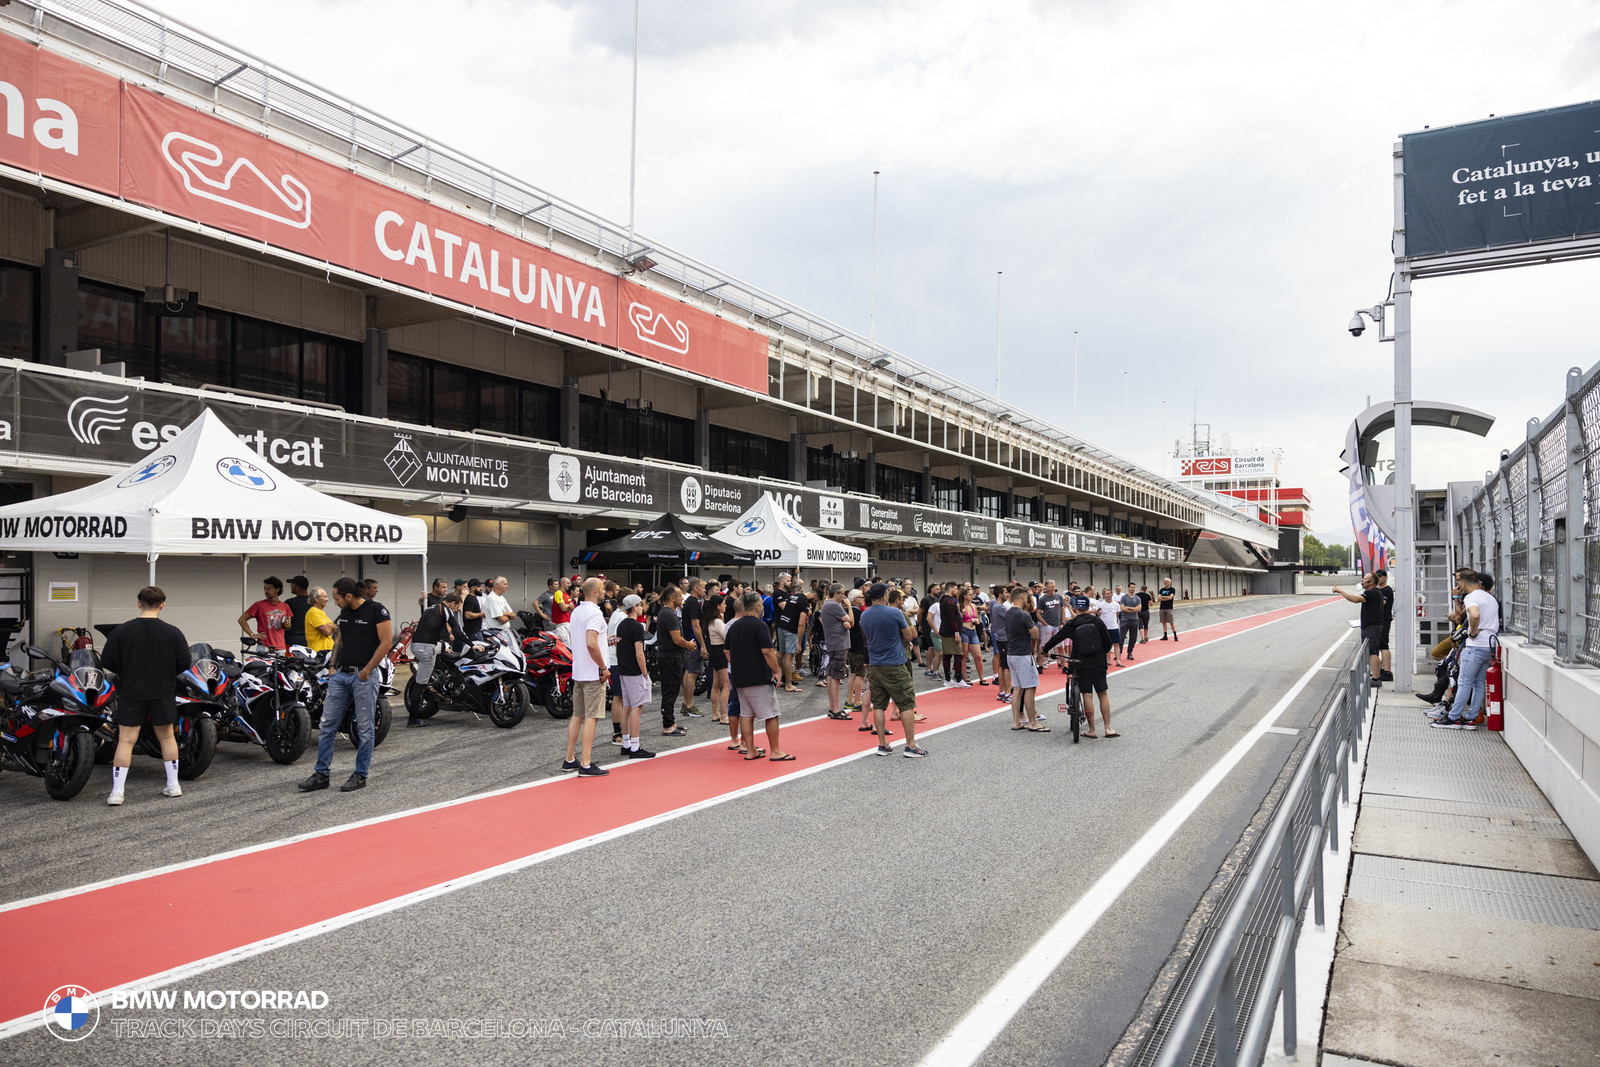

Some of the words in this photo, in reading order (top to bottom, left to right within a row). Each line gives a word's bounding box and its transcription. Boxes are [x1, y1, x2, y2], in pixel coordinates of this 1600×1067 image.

[1452, 155, 1579, 184] Catalunya,
[1458, 189, 1487, 205] fet
[1494, 187, 1507, 200] a
[1514, 181, 1535, 197] la
[1542, 175, 1592, 193] teva
[374, 210, 606, 327] CATALUNYA
[426, 451, 493, 470] AJUNTAMENT
[495, 459, 509, 472] DE
[426, 466, 509, 488] MONTMELÓ
[584, 465, 646, 487] Ajuntament
[585, 484, 599, 499] de
[601, 485, 653, 505] Barcelona
[704, 484, 742, 500] Diputació
[704, 499, 742, 514] Barcelona
[871, 506, 898, 519] Generalitat
[24, 515, 128, 538] MOTORRAD
[191, 517, 262, 540] BMW
[271, 519, 403, 543] MOTORRAD
[871, 519, 878, 529] de
[879, 519, 902, 534] Catalunya
[922, 521, 953, 537] esportcat
[806, 549, 824, 560] BMW
[825, 550, 861, 562] MOTORRAD
[207, 664, 218, 676] 2
